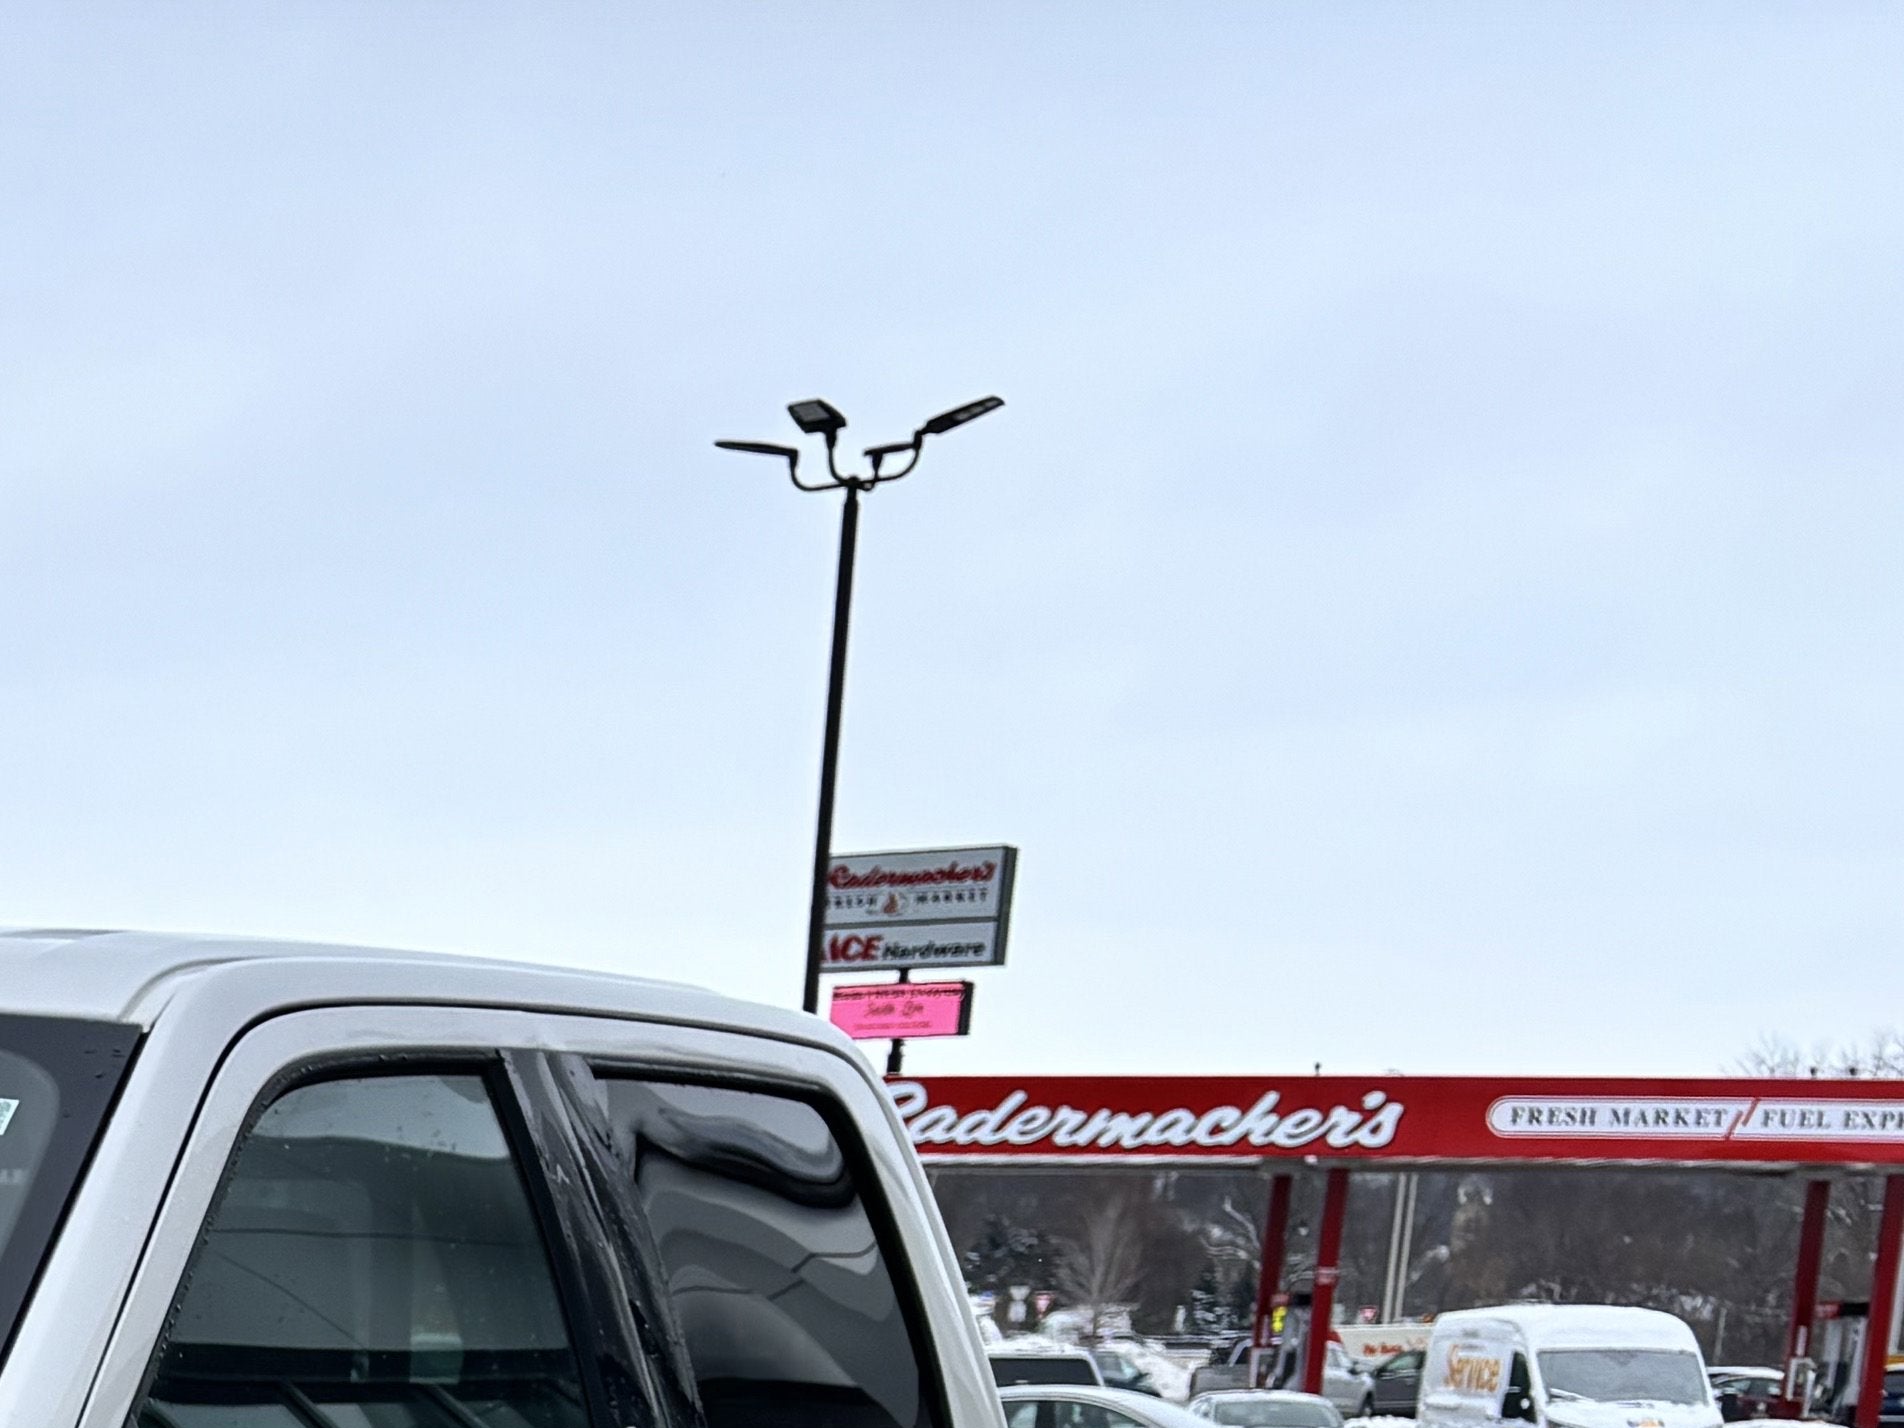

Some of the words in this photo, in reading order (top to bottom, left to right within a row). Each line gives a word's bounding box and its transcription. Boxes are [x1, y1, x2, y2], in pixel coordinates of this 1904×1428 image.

[883, 939, 986, 960] Hardware
[1510, 1105, 1597, 1128] FRESH
[1609, 1107, 1729, 1129] MARKET
[1760, 1109, 1832, 1130] FUEL
[1843, 1110, 1904, 1131] EXP
